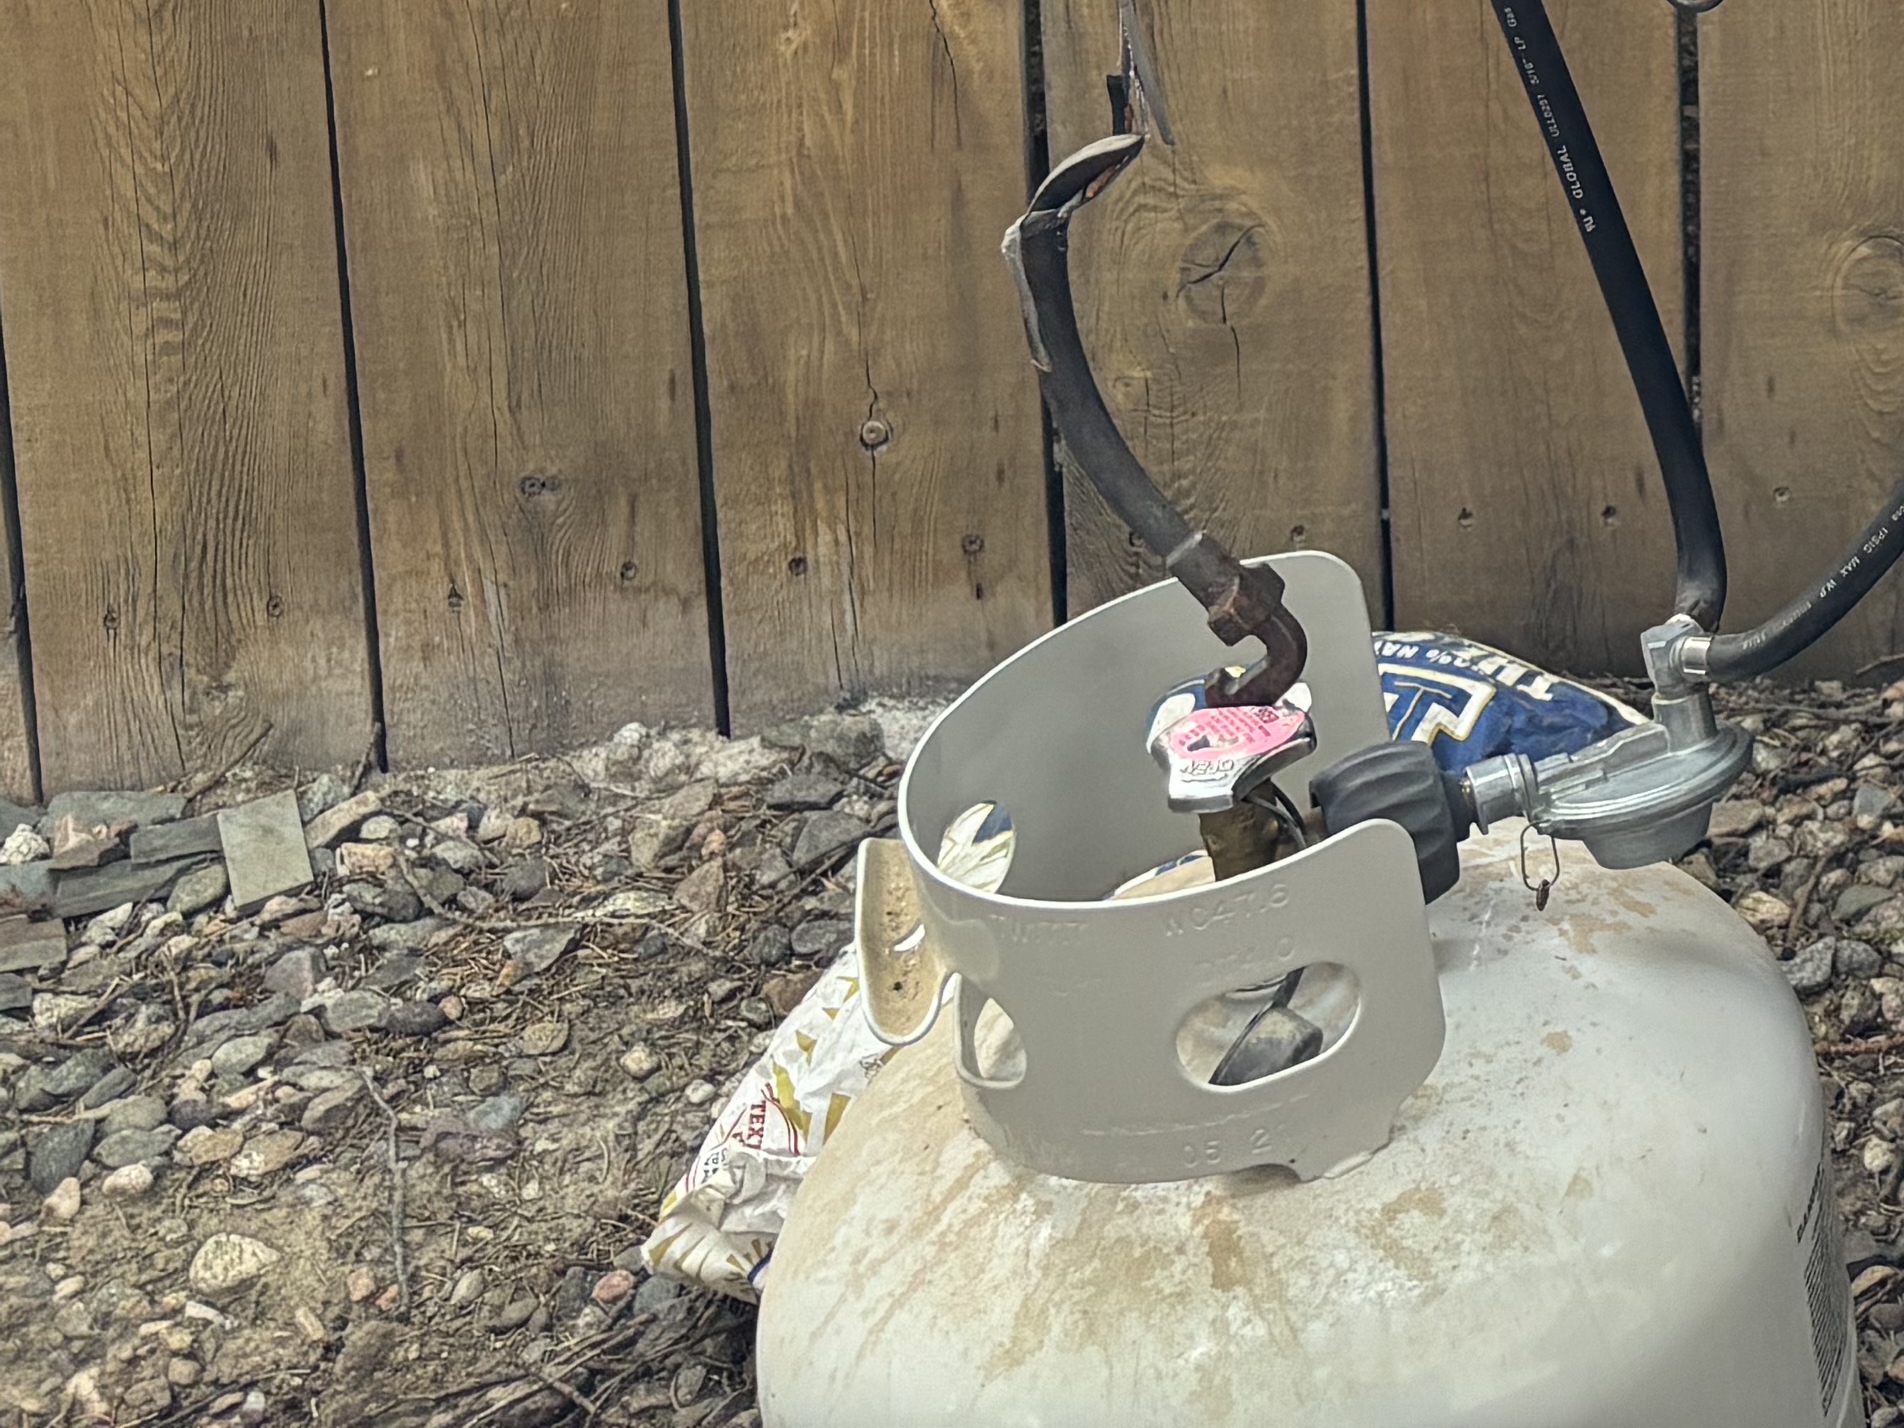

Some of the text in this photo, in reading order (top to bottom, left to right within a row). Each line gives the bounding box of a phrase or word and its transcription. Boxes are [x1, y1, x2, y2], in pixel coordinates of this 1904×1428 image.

[1504, 7, 1517, 28] Gas
[1514, 36, 1526, 50] LP
[1557, 145, 1584, 199] GLOBAL
[1840, 556, 1860, 577] MAX
